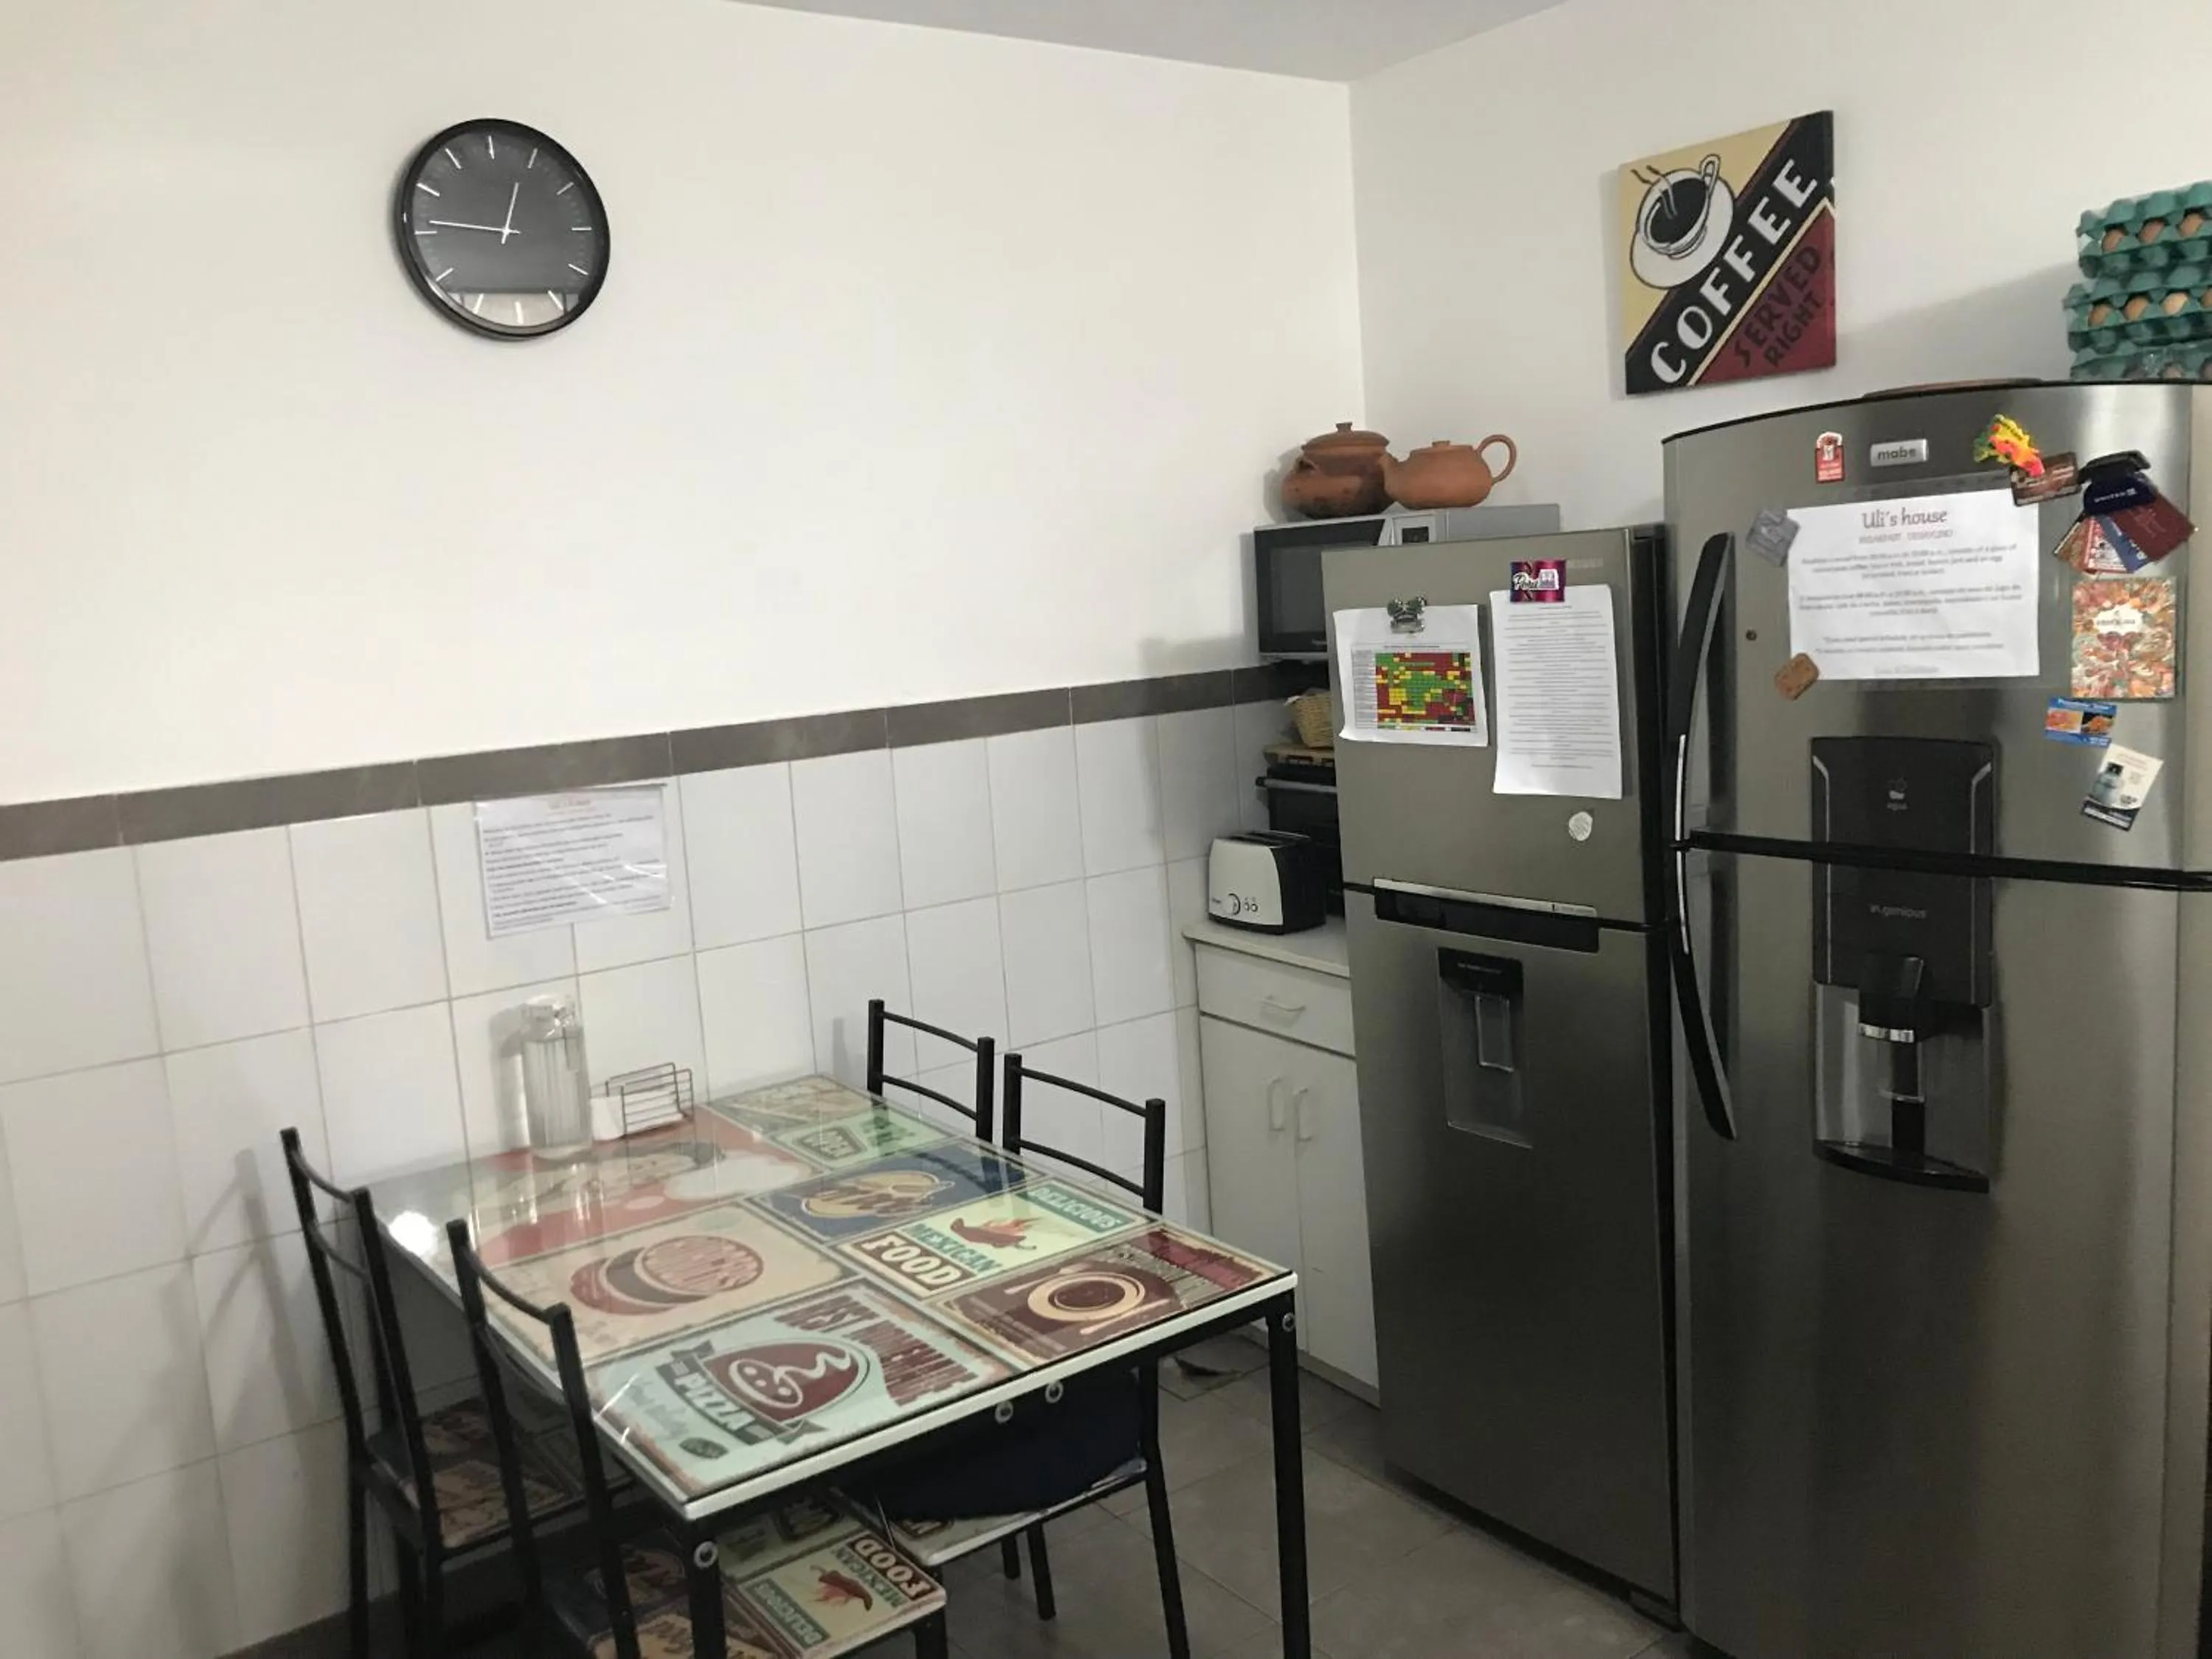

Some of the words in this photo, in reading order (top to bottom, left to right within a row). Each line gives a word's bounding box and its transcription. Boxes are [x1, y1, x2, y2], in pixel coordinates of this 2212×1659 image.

[1651, 158, 1818, 383] COFFEE
[1733, 246, 1822, 367] SERVED
[1764, 291, 1823, 367] RIGHT
[1877, 446, 1917, 461] mabe
[1901, 507, 1948, 526] house
[1027, 1186, 1122, 1229] DELICIOUS
[861, 1234, 963, 1286] FOOD
[905, 1223, 1003, 1273] MEXICAN
[673, 1372, 757, 1431] PIZZA
[854, 1537, 934, 1599] FOOD
